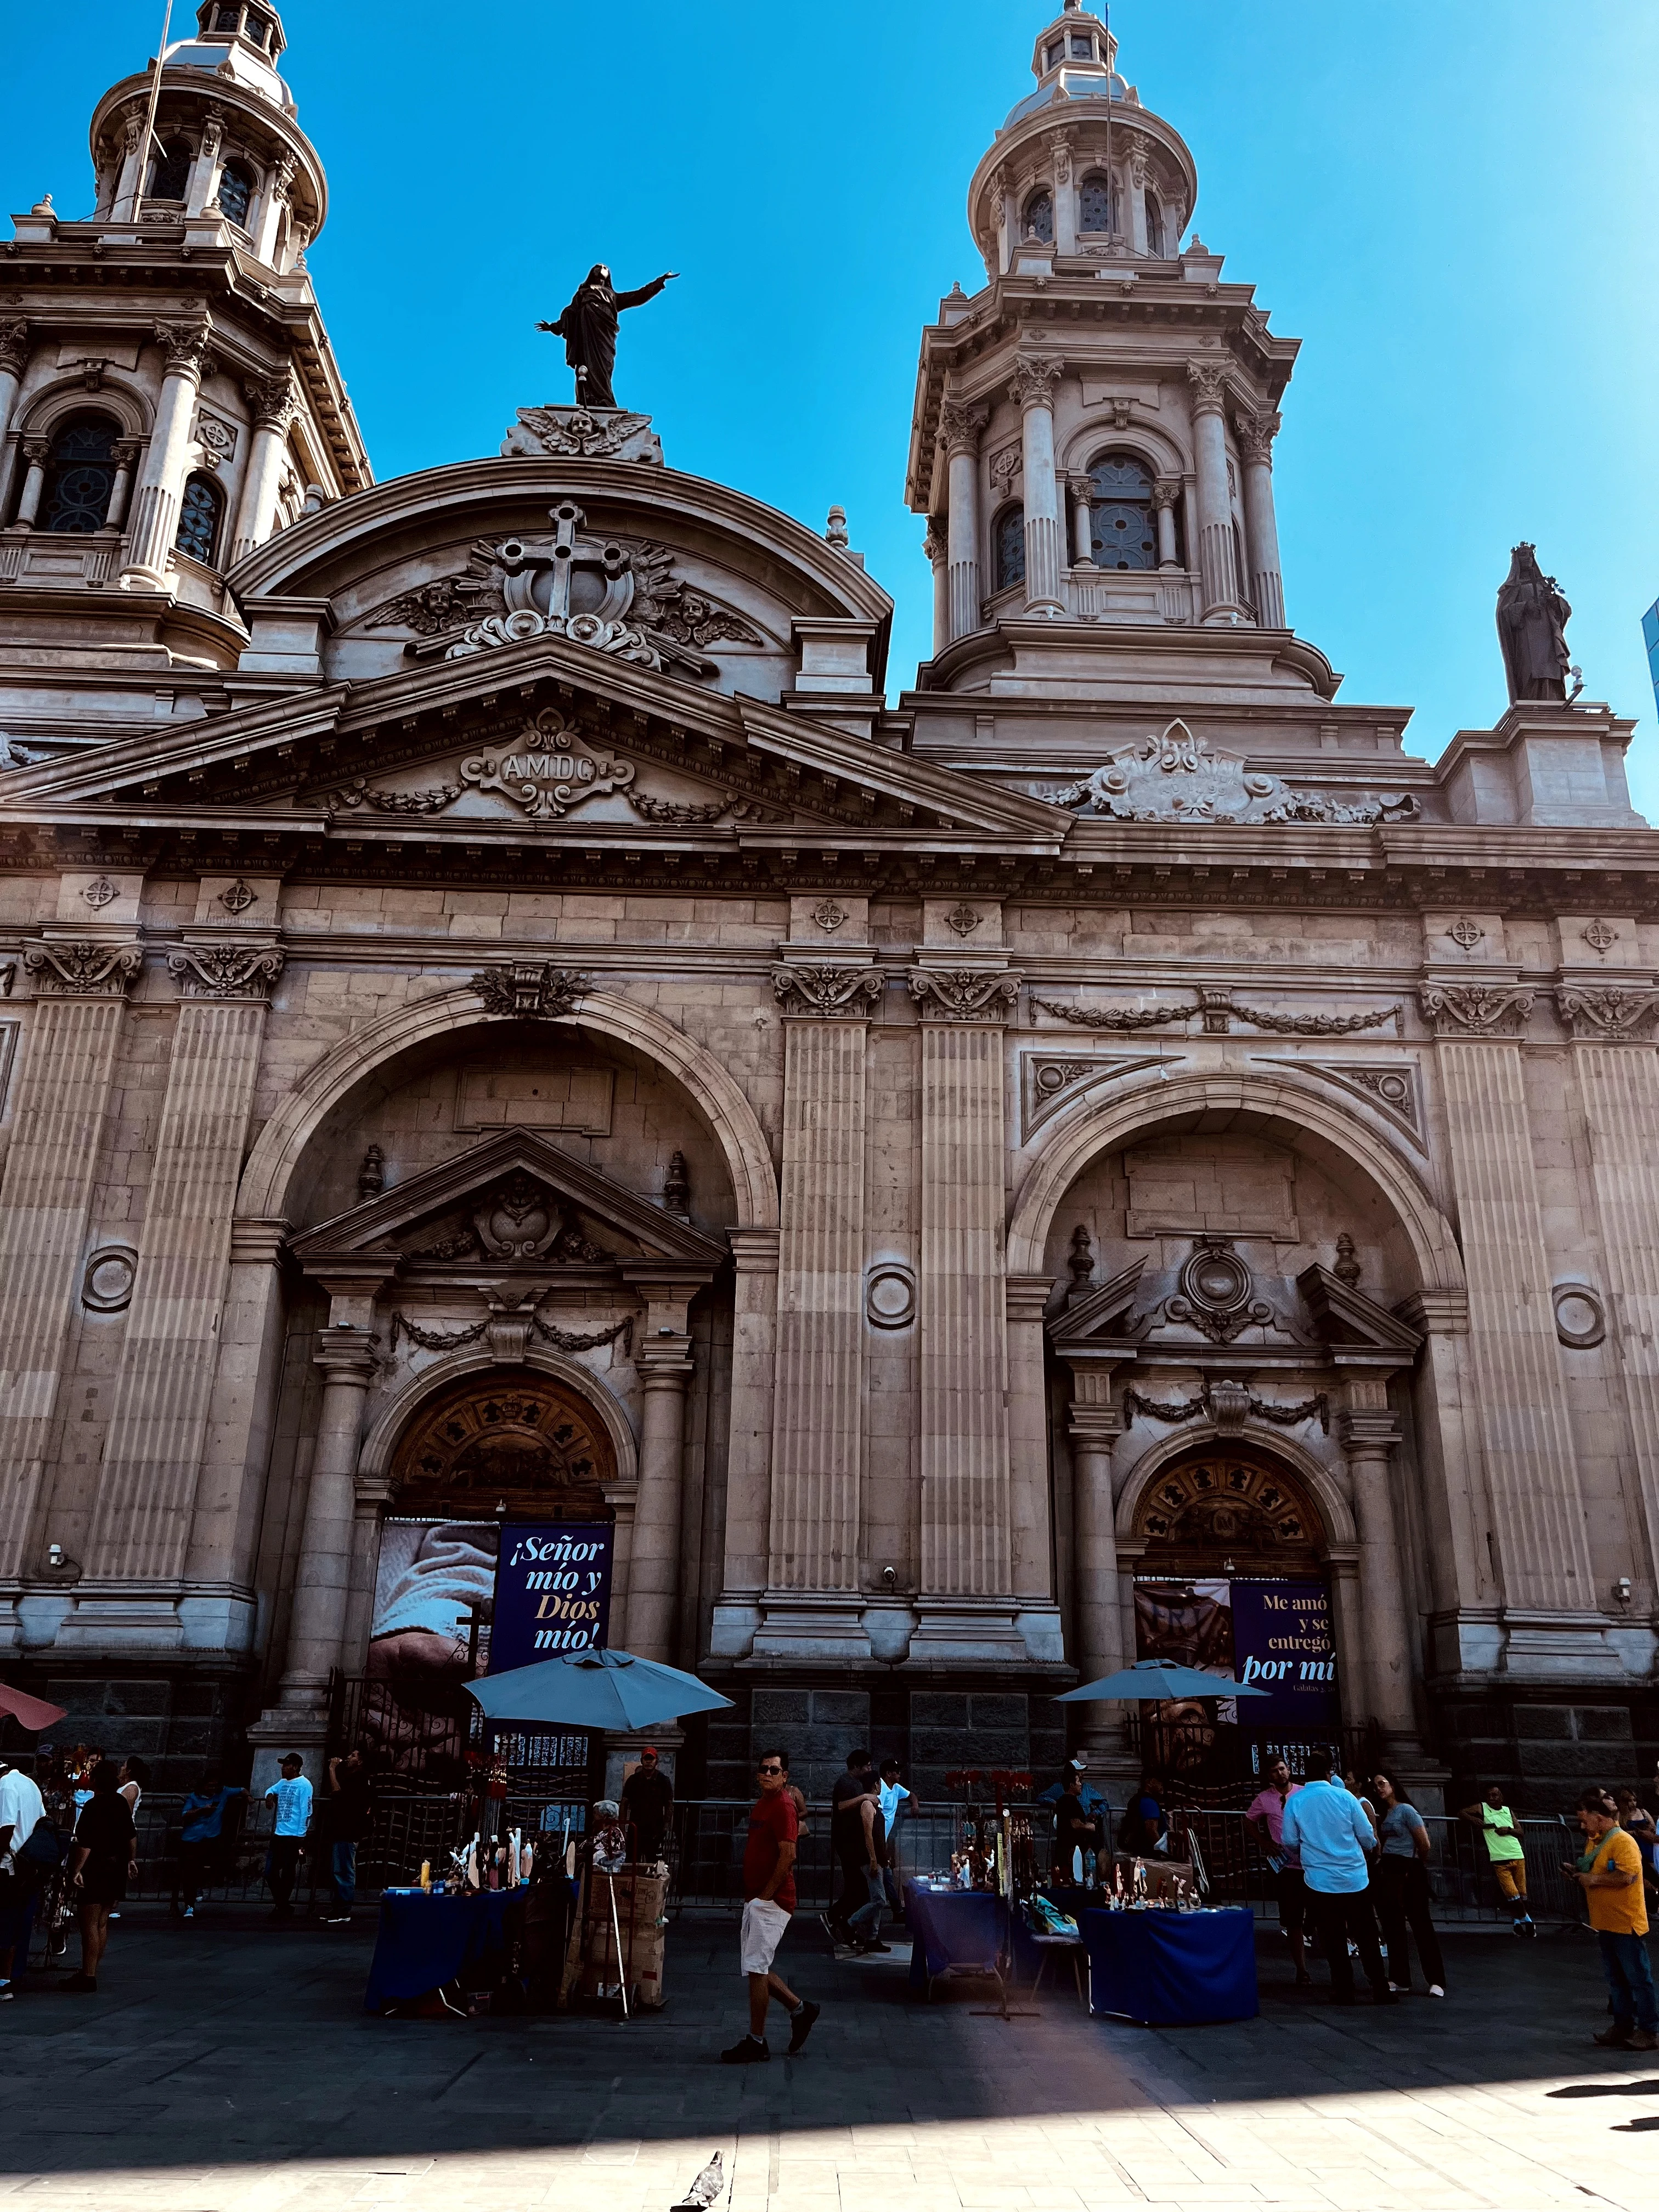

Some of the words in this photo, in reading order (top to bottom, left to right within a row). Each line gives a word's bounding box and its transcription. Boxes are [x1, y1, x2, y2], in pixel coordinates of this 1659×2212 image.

[504, 754, 592, 781] AMDG
[510, 1535, 605, 1566] ¡Señor
[526, 1562, 579, 1590] mío
[582, 1572, 602, 1595] y
[534, 1593, 600, 1620] Dios
[1262, 1595, 1289, 1610] Me
[1292, 1594, 1327, 1611] amó
[534, 1620, 600, 1649] mío!
[1299, 1619, 1308, 1633] y
[1312, 1618, 1329, 1630] se
[1268, 1633, 1330, 1654] entregó
[1242, 1655, 1293, 1685] por
[1299, 1652, 1336, 1681] mí
